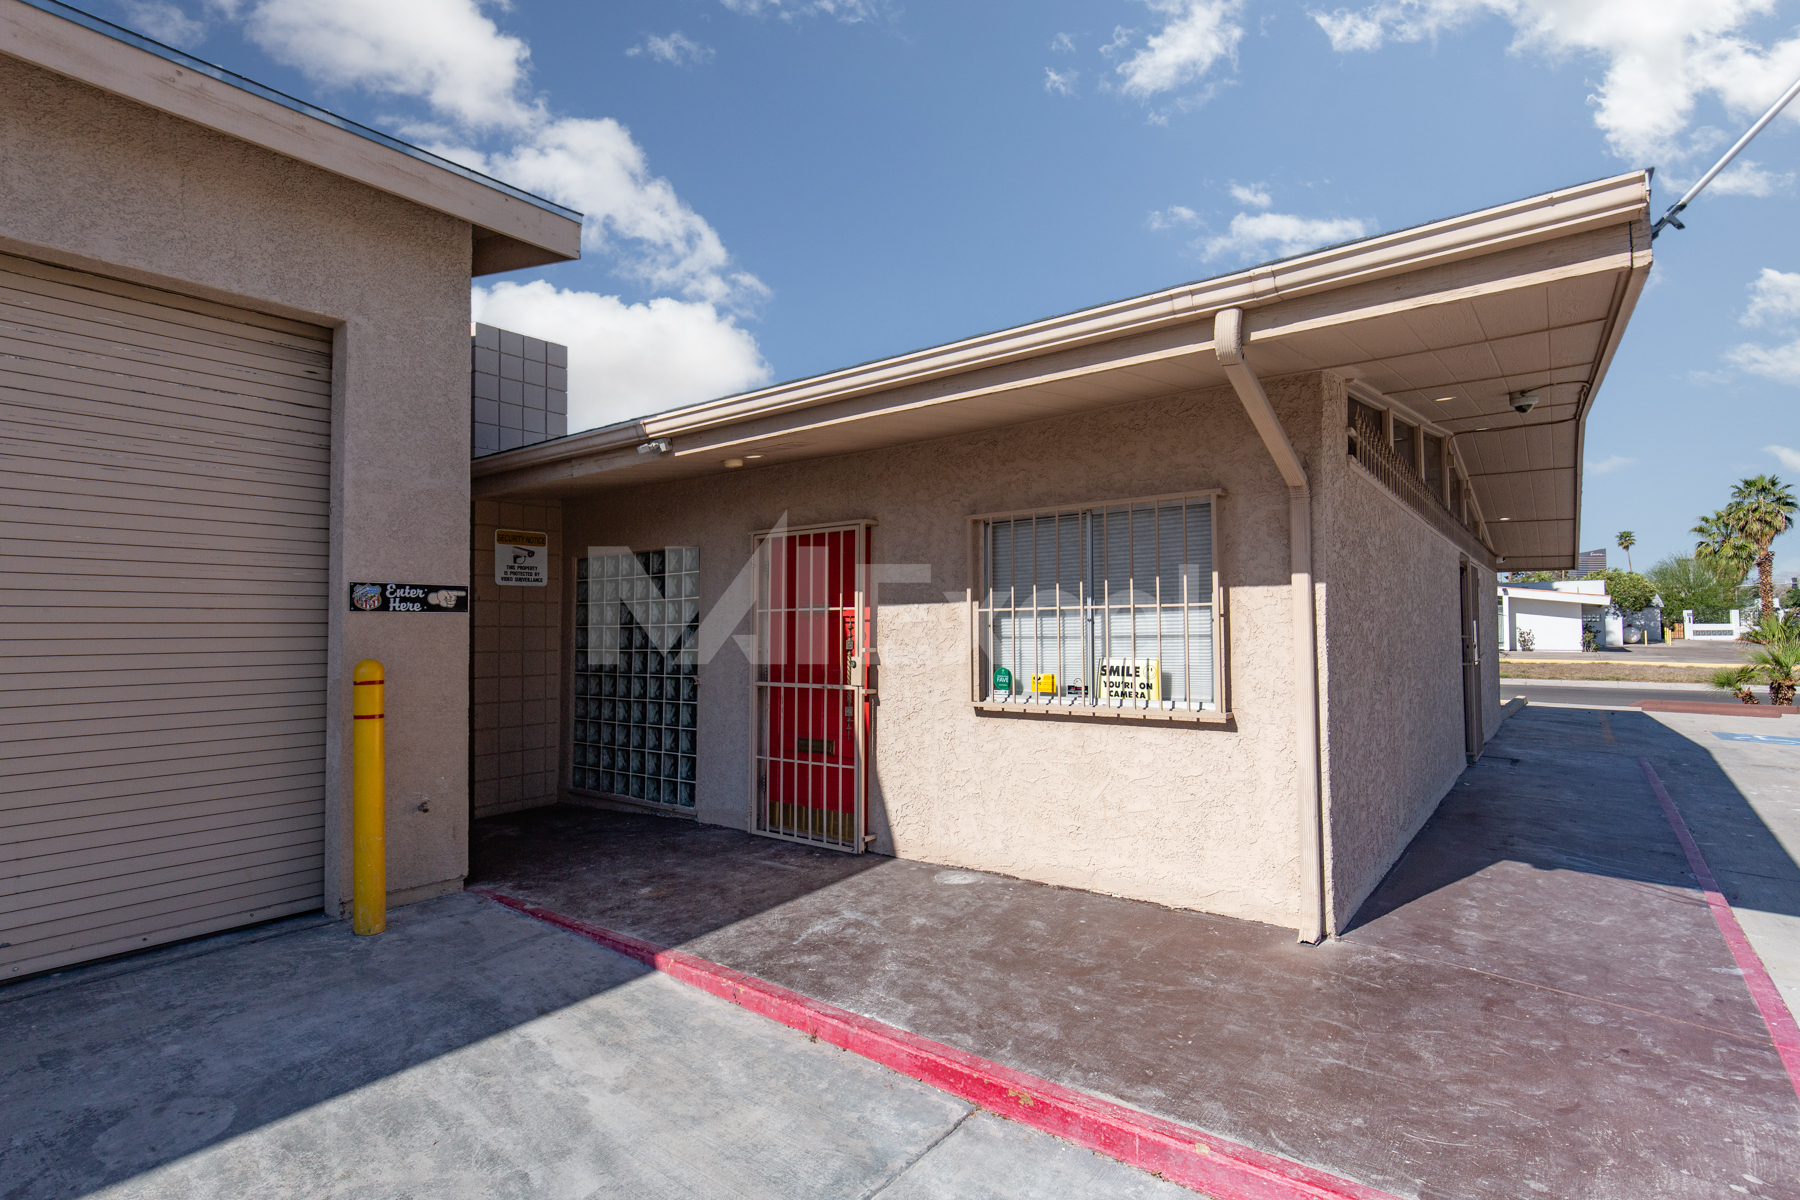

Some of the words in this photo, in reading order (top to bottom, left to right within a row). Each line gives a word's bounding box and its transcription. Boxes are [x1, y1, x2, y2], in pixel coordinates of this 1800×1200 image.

[497, 534, 524, 543] SECURITY
[525, 536, 546, 545] NOTICE
[386, 583, 425, 598] Enter
[389, 597, 422, 611] Here
[1100, 665, 1140, 677] SMILE
[1139, 682, 1153, 690] ON
[1109, 690, 1146, 699] CAMERA
